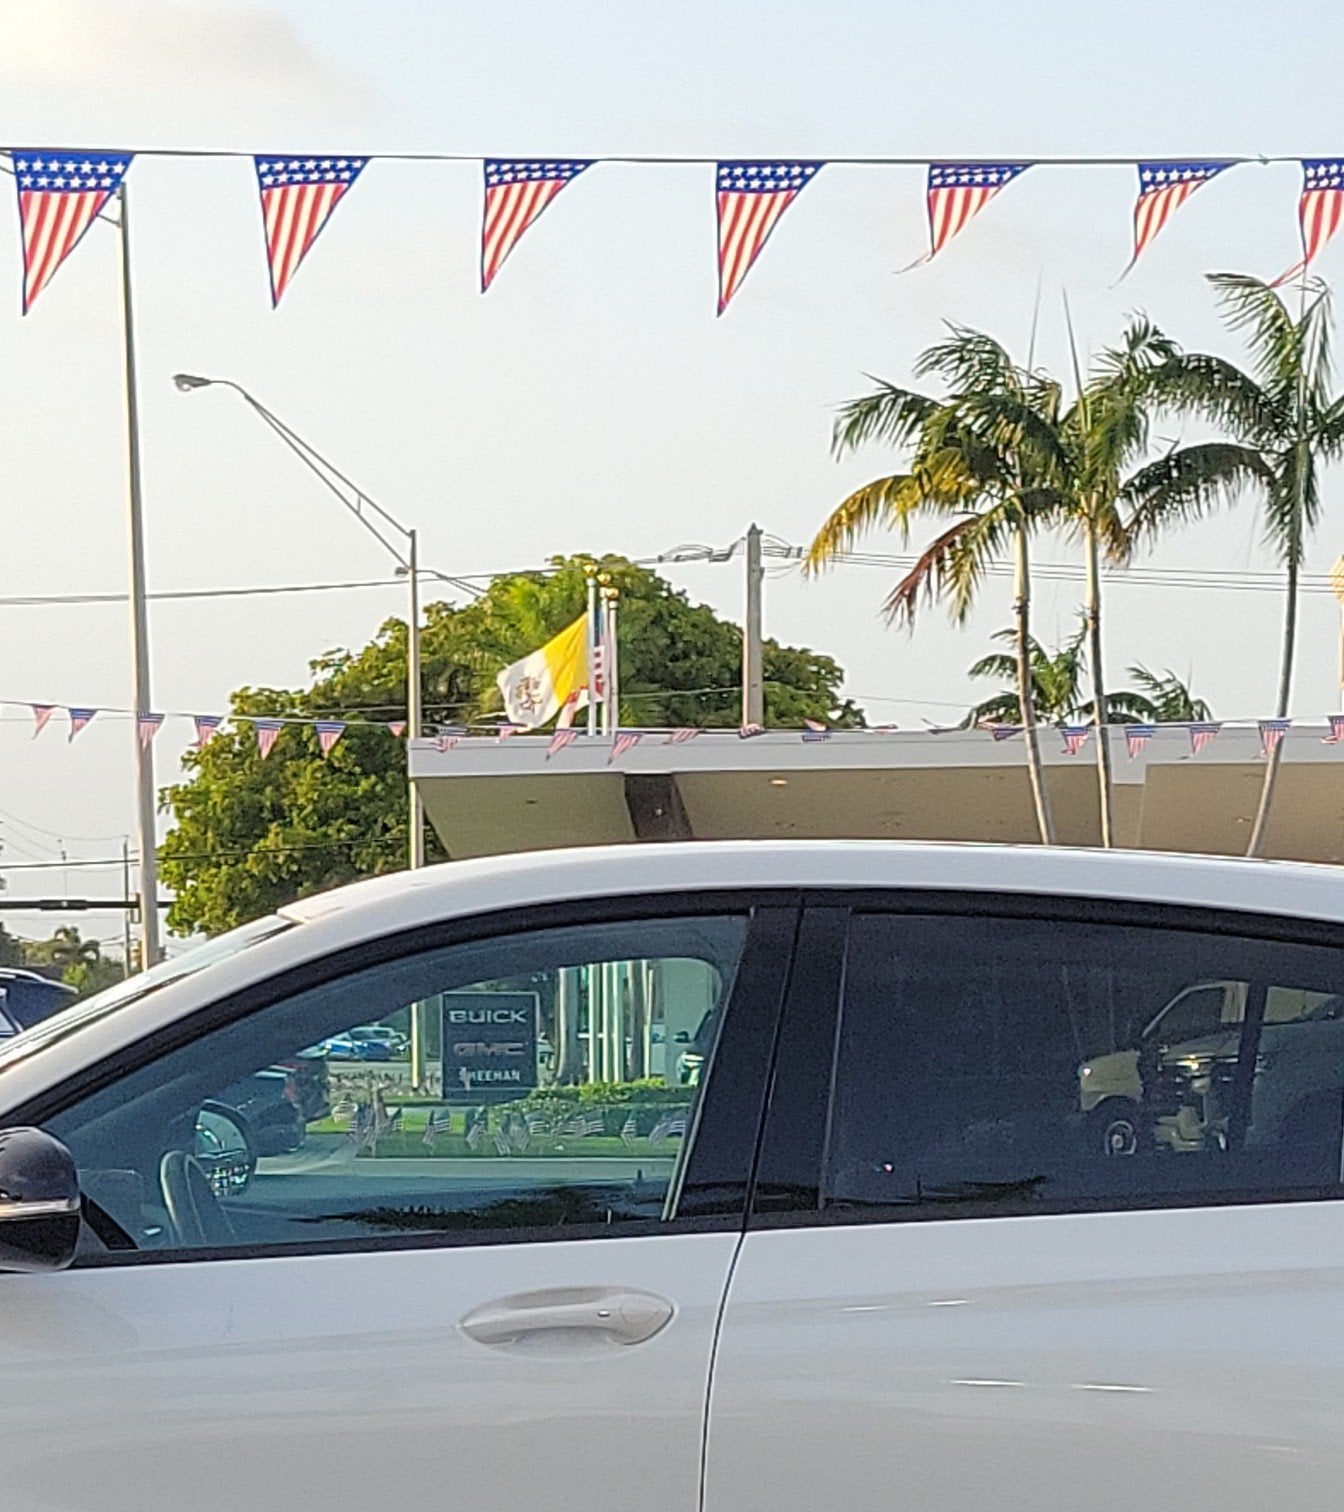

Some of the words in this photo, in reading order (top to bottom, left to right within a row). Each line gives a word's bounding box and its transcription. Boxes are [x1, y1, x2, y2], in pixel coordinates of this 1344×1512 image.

[449, 1010, 527, 1023] BUICK
[454, 1042, 525, 1055] GMC
[459, 1069, 521, 1081] HEEHAN
